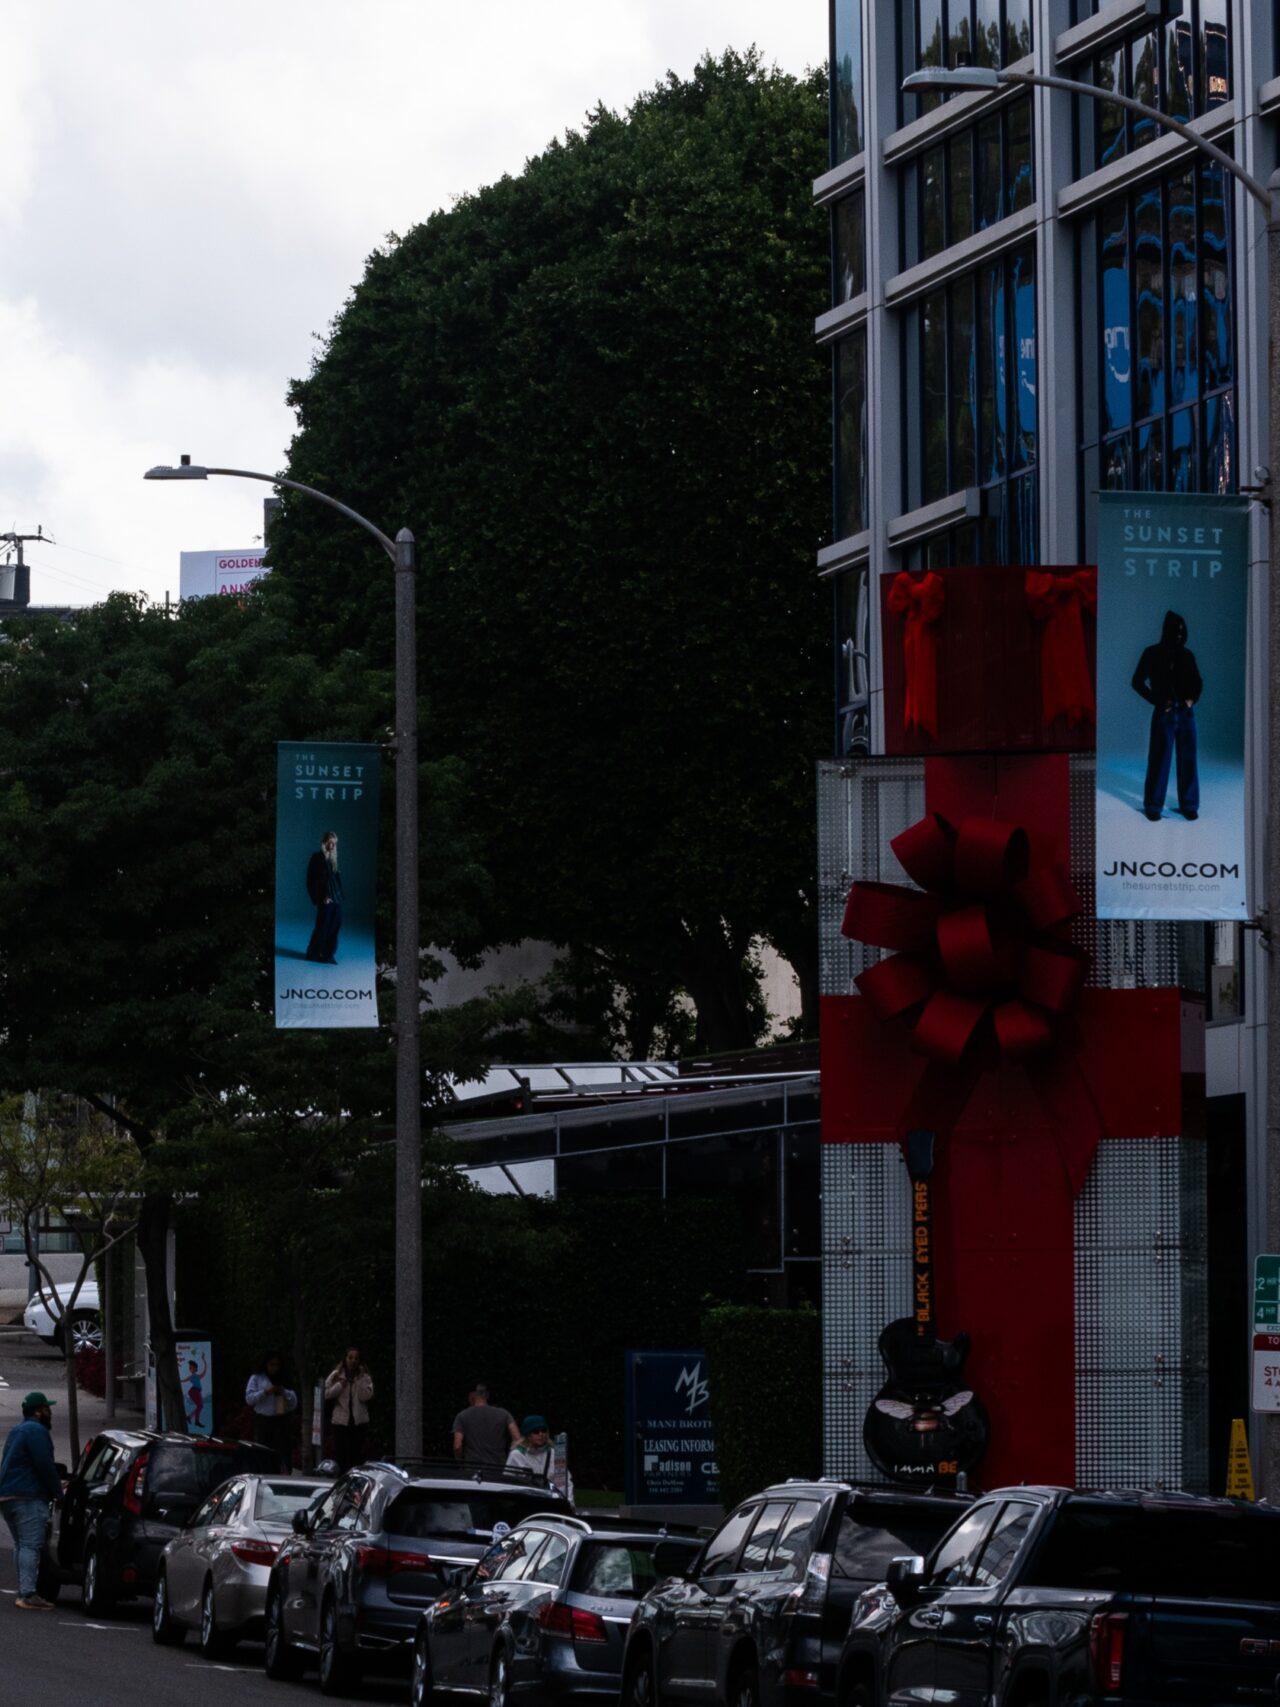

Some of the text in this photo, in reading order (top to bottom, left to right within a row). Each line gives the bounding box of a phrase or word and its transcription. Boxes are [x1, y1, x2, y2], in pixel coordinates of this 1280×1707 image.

[1123, 509, 1151, 519] THE
[1123, 525, 1223, 544] SUNSET
[1124, 558, 1222, 578] STRIP
[220, 584, 251, 595] ANN
[295, 764, 364, 778] SUNSET
[295, 786, 363, 800] STRIP
[1104, 861, 1239, 878] JNCO.COM
[1122, 881, 1220, 892] thesunsetstrip.com
[280, 989, 372, 1000] JNCO.COM
[1256, 1307, 1264, 1319] 4
[647, 1419, 677, 1429] MANI
[644, 1439, 679, 1452] LEASING
[938, 1461, 959, 1475] BE
